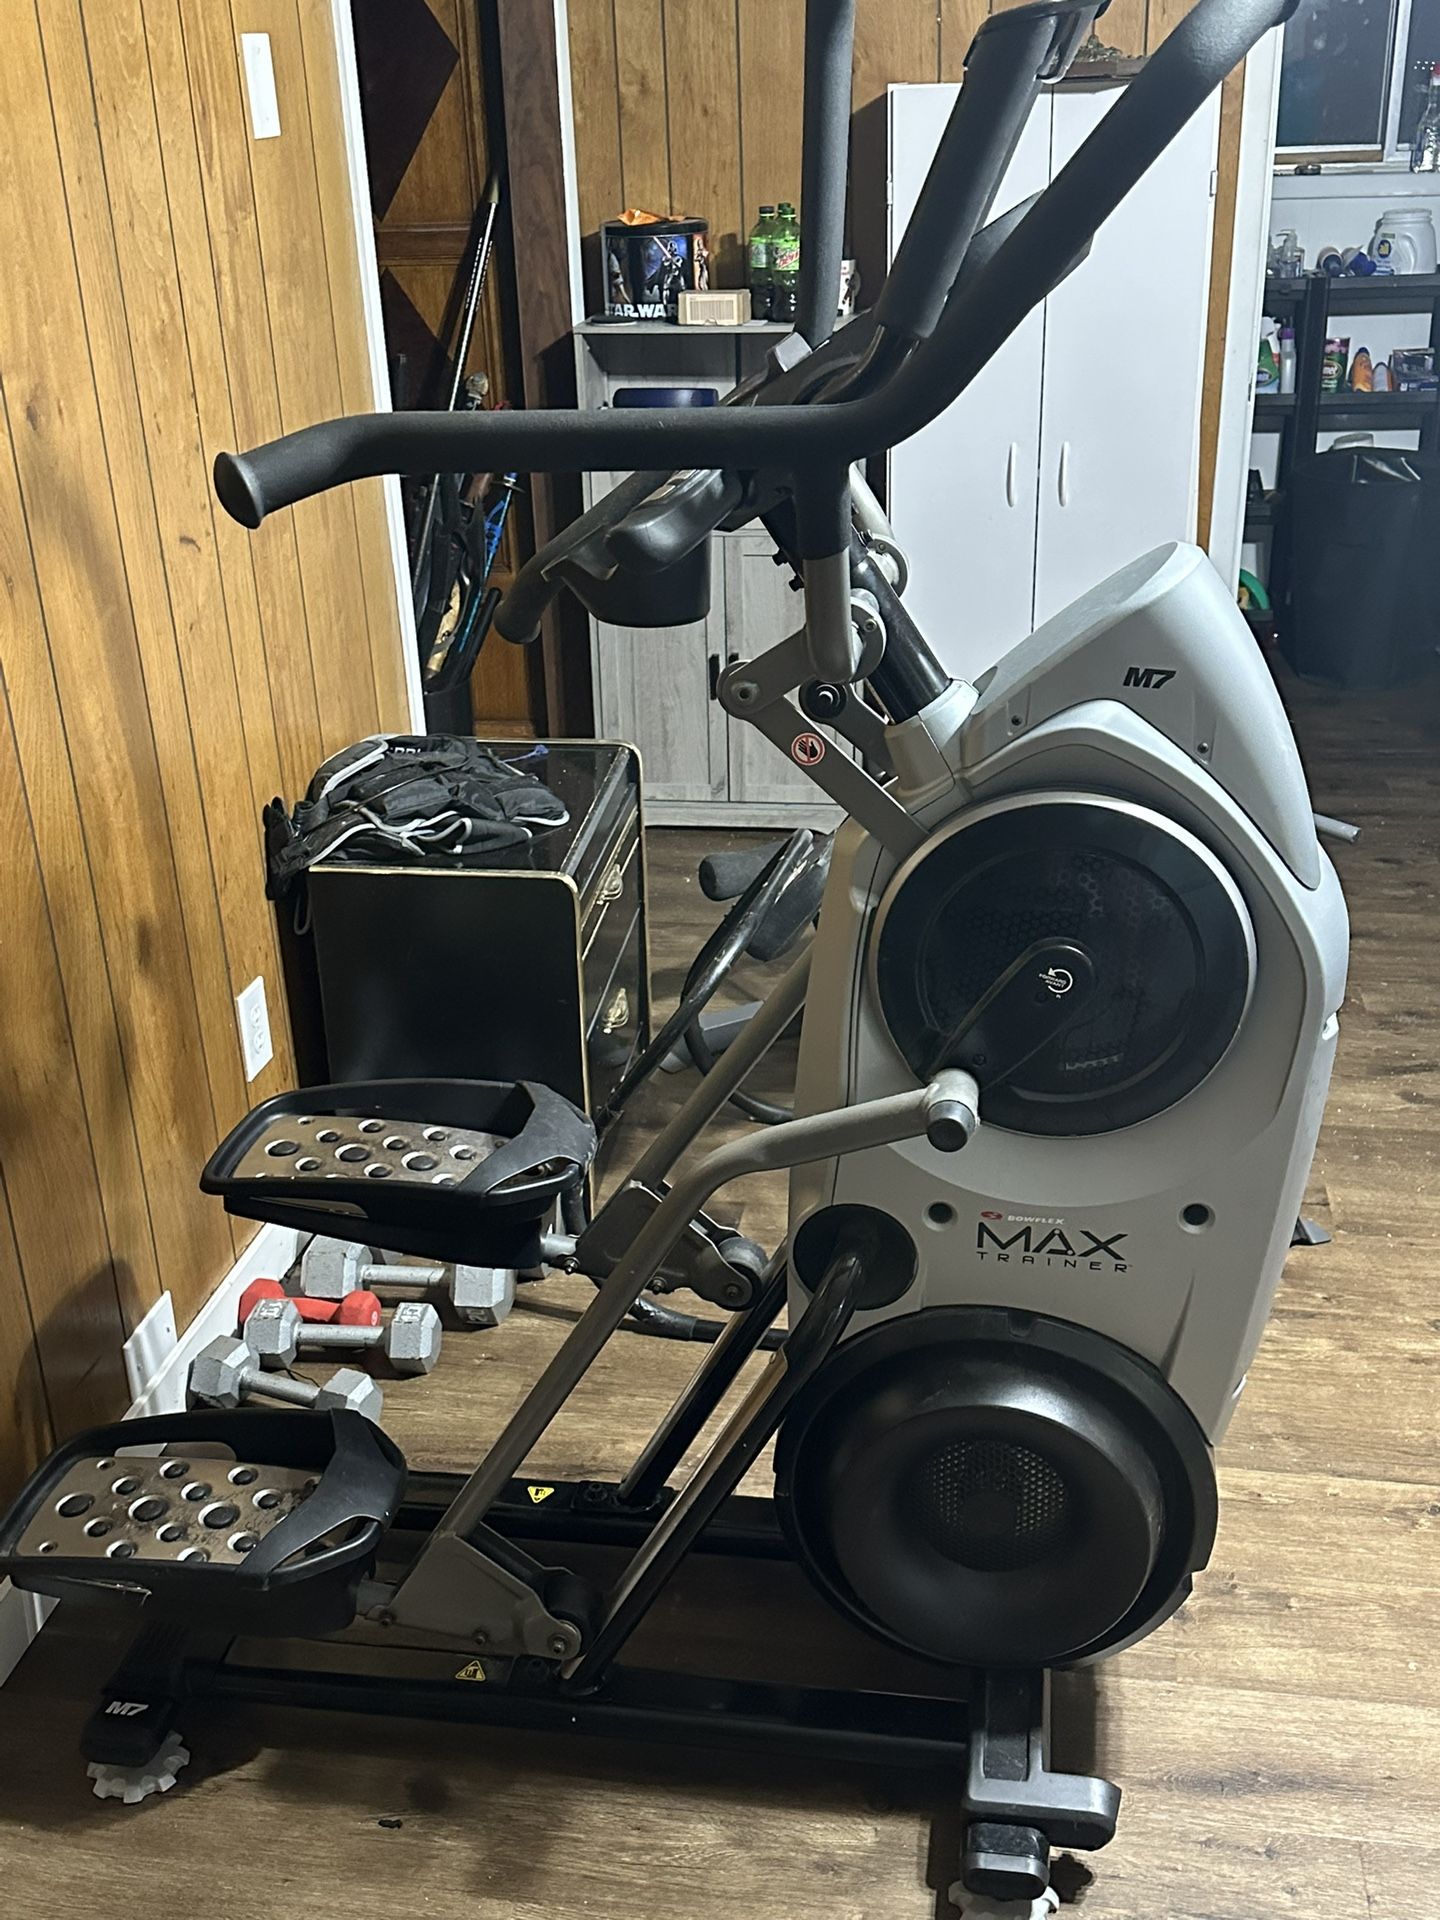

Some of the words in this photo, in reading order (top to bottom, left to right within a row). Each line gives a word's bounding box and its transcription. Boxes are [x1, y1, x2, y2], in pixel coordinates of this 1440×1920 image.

[1122, 666, 1177, 689] M7
[1007, 1215, 1065, 1225] BOWFLEX
[977, 1222, 1128, 1261] MAX
[976, 1251, 1128, 1273] TRAINER
[105, 1701, 149, 1716] M7
